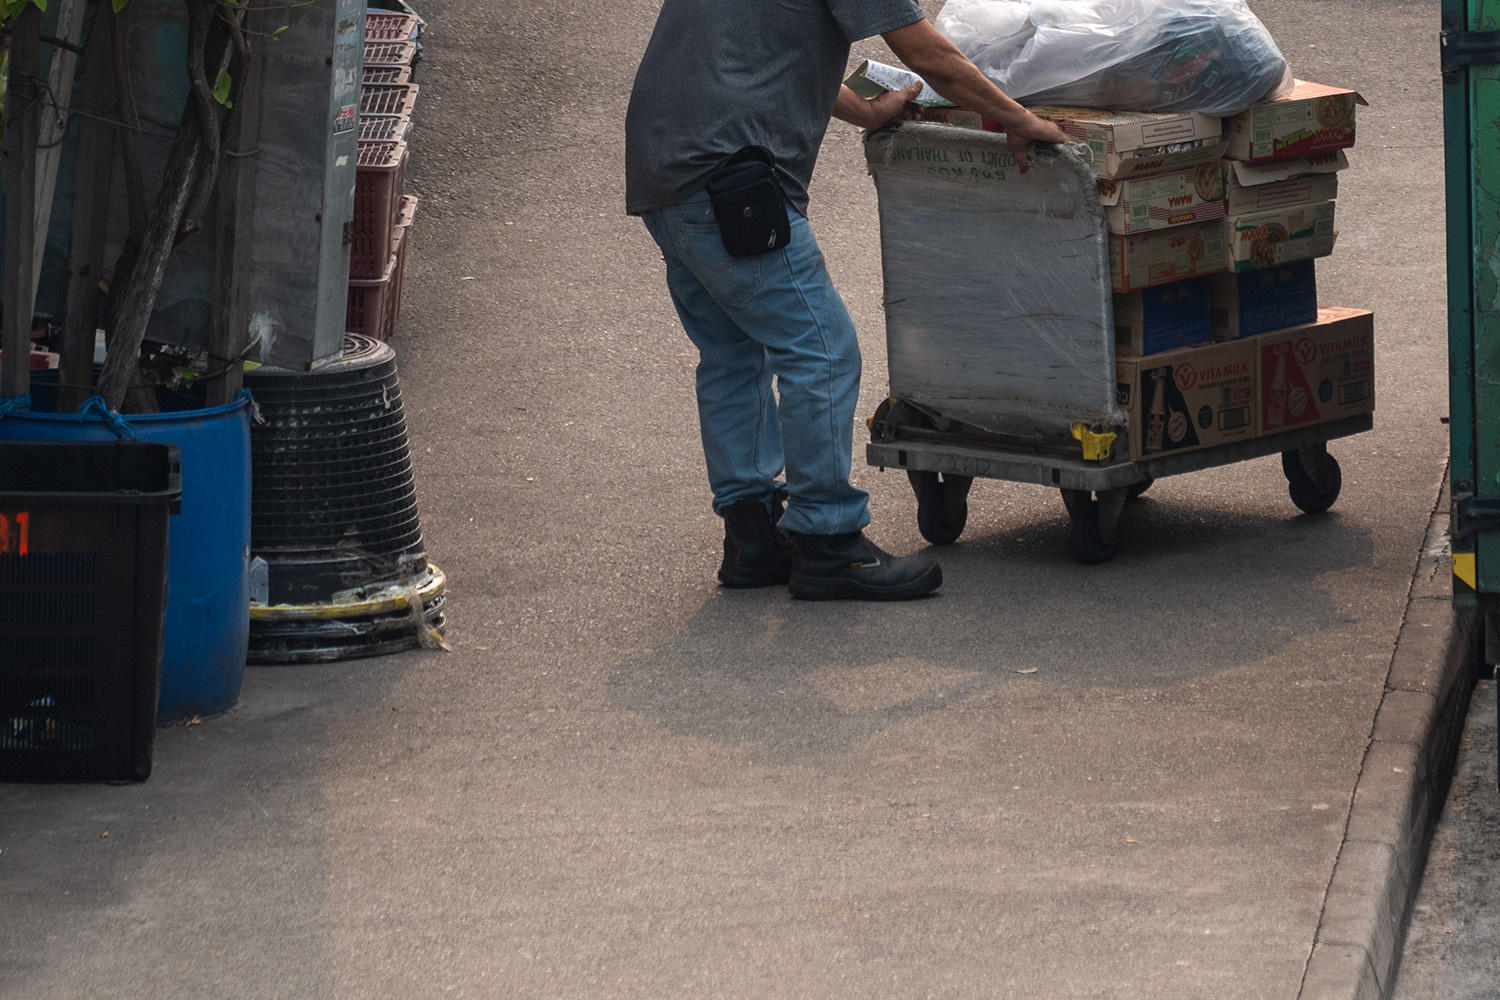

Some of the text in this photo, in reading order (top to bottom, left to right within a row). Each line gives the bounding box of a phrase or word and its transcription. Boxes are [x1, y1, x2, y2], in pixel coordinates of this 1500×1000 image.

[1168, 193, 1193, 208] MAMA
[1240, 227, 1269, 243] MAMA
[1319, 334, 1370, 357] VITAMILK
[1199, 361, 1251, 382] VITAMILK
